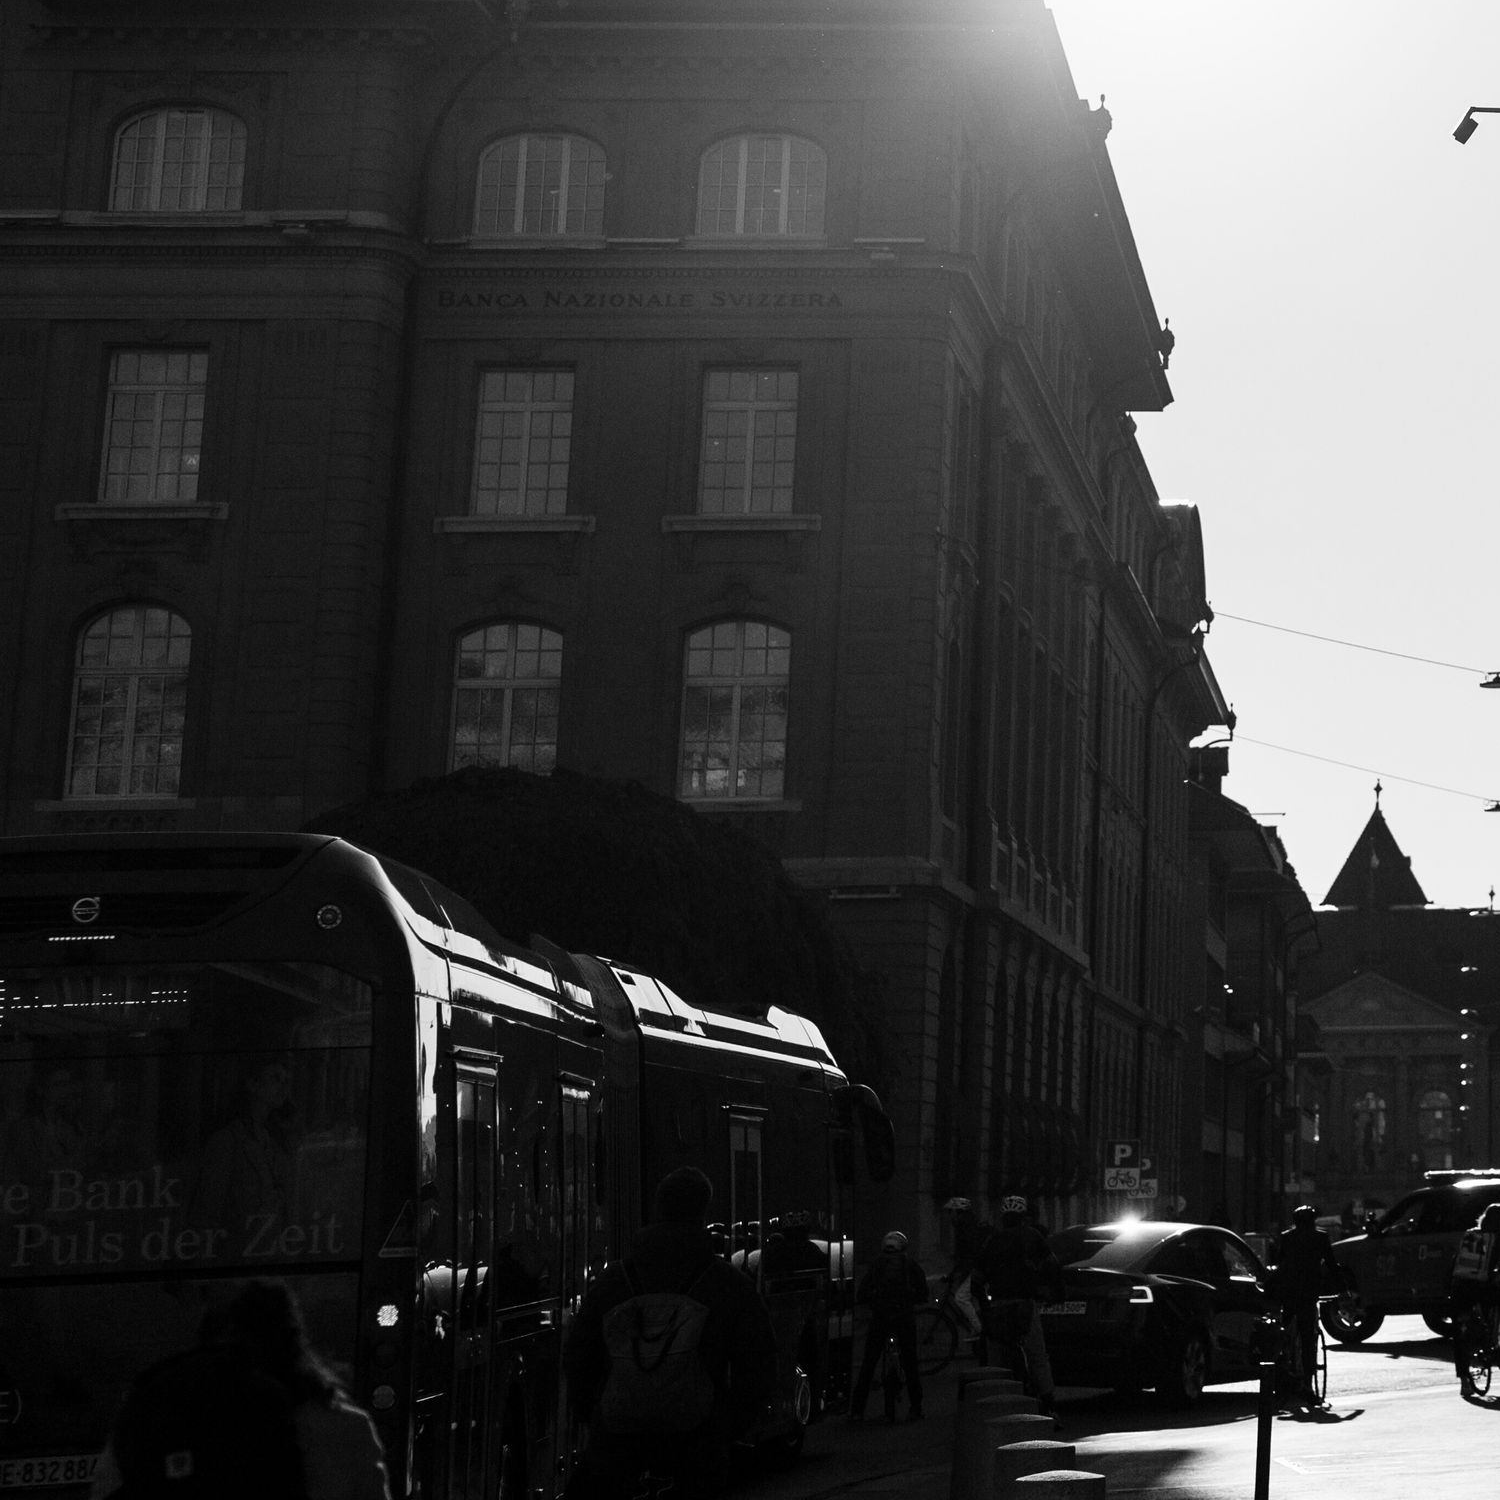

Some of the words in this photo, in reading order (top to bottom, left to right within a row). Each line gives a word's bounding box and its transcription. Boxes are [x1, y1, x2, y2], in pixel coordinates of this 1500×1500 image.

[437, 290, 528, 308] BANCA
[543, 290, 695, 308] NAZIONALE
[710, 290, 843, 308] SVIZZERA
[1114, 1143, 1133, 1166] P
[46, 1164, 182, 1213] Bank
[10, 1219, 125, 1268] Puls
[140, 1215, 229, 1262] der
[241, 1210, 346, 1258] Zeit
